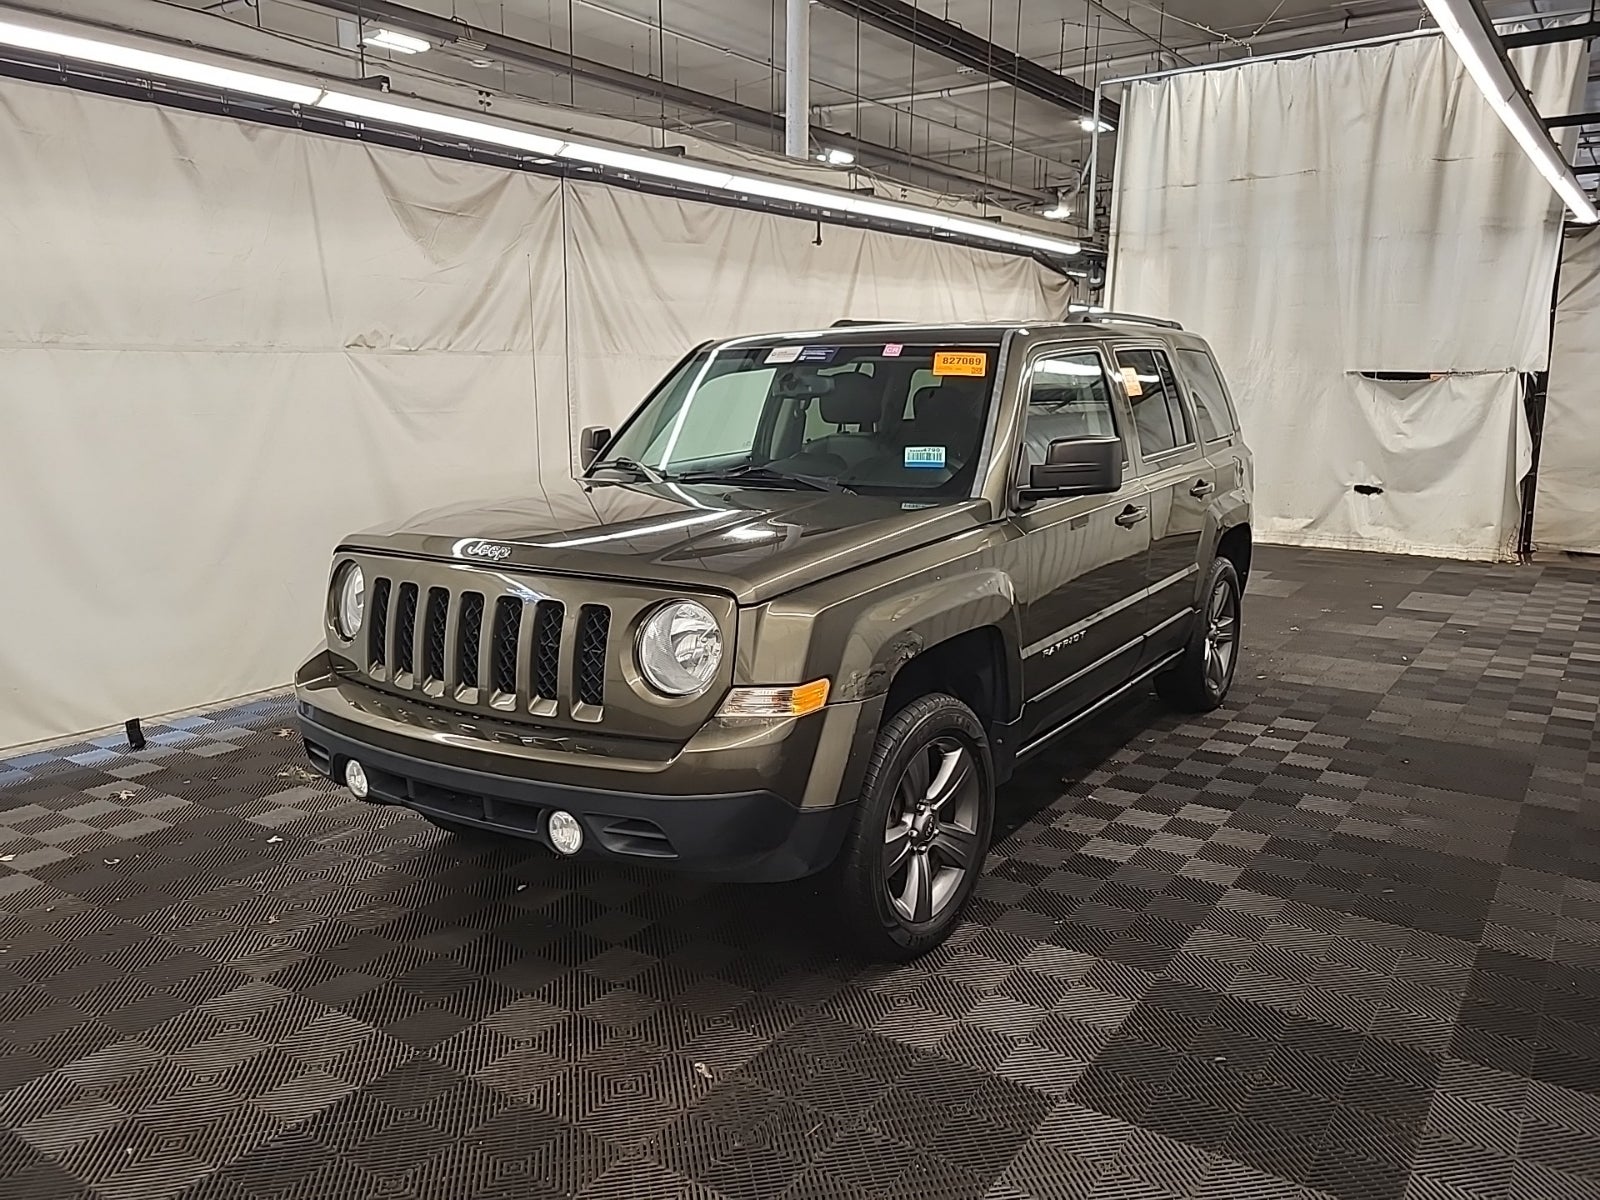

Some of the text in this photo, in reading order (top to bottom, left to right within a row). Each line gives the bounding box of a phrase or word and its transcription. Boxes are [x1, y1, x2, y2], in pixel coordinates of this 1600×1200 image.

[942, 356, 982, 366] 827089
[467, 540, 512, 561] Jeep
[1041, 629, 1087, 658] PATRIOT
